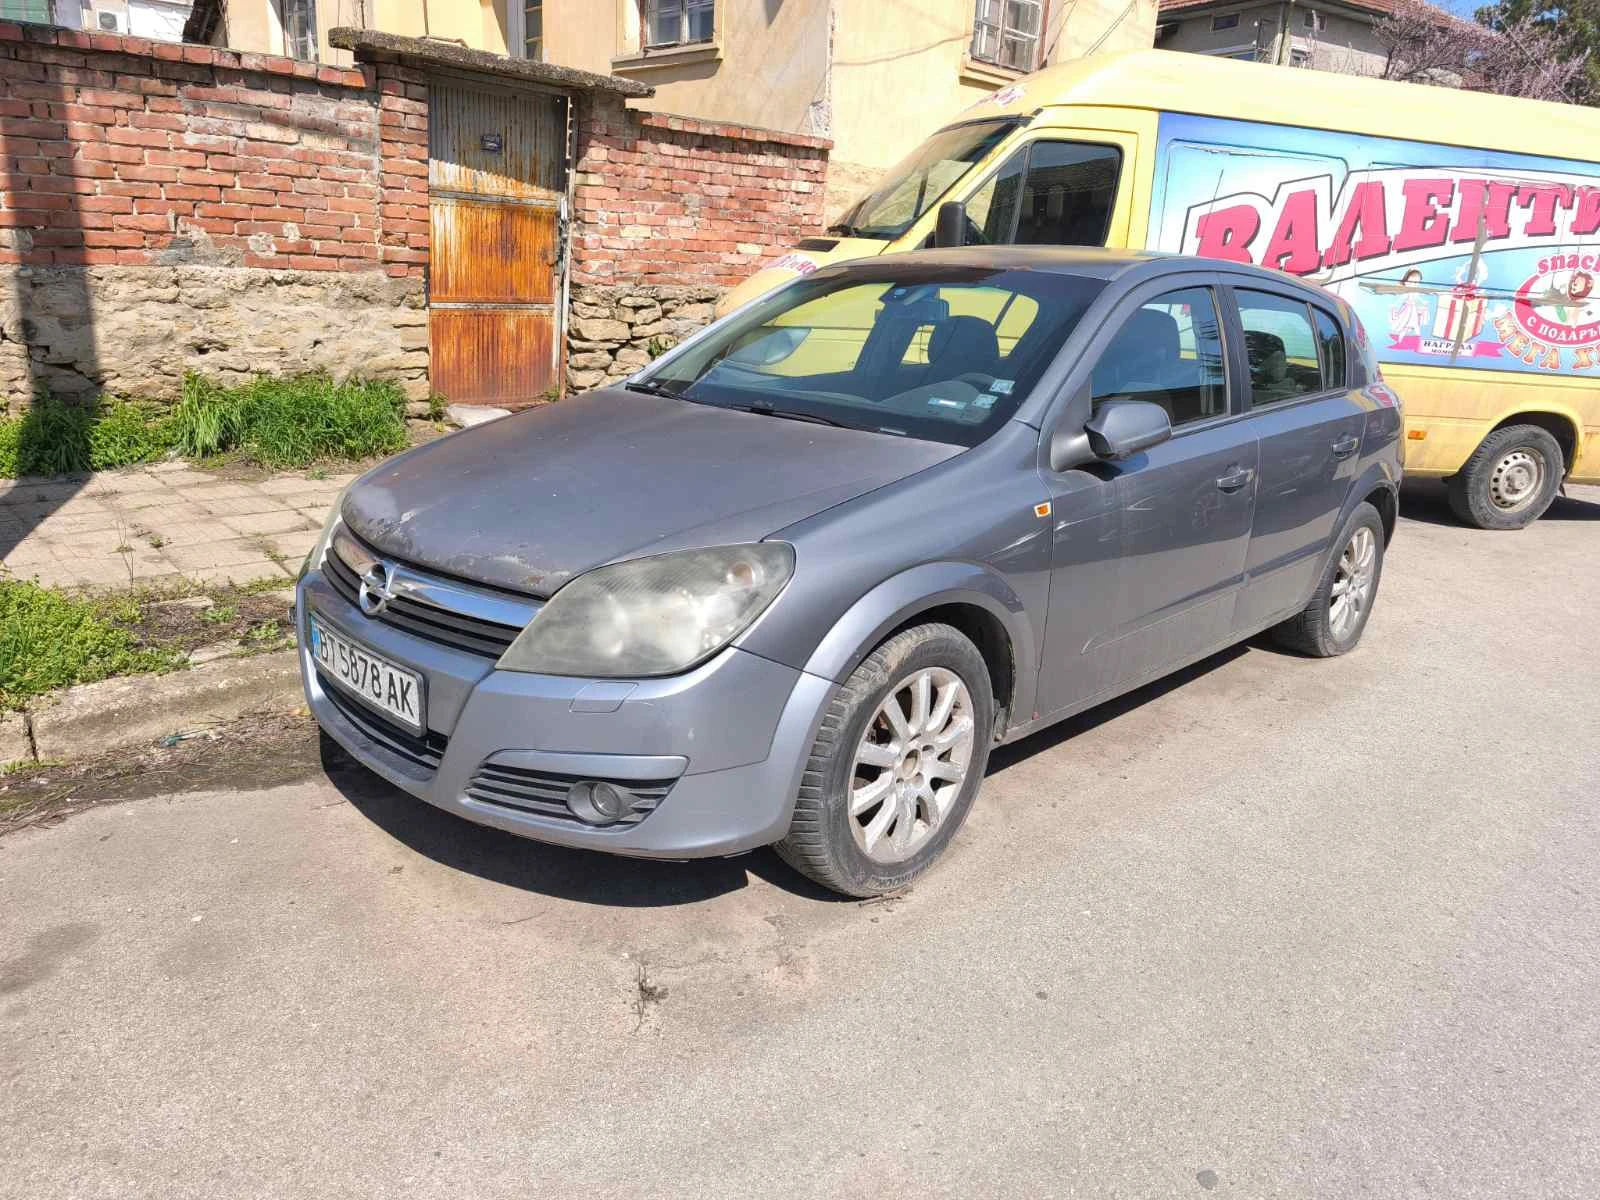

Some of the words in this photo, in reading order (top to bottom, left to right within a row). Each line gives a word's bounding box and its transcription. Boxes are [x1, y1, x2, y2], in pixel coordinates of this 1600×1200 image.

[1538, 323, 1600, 341] ПОДАРЪ
[340, 642, 382, 699] 5878
[387, 671, 414, 718] AK
